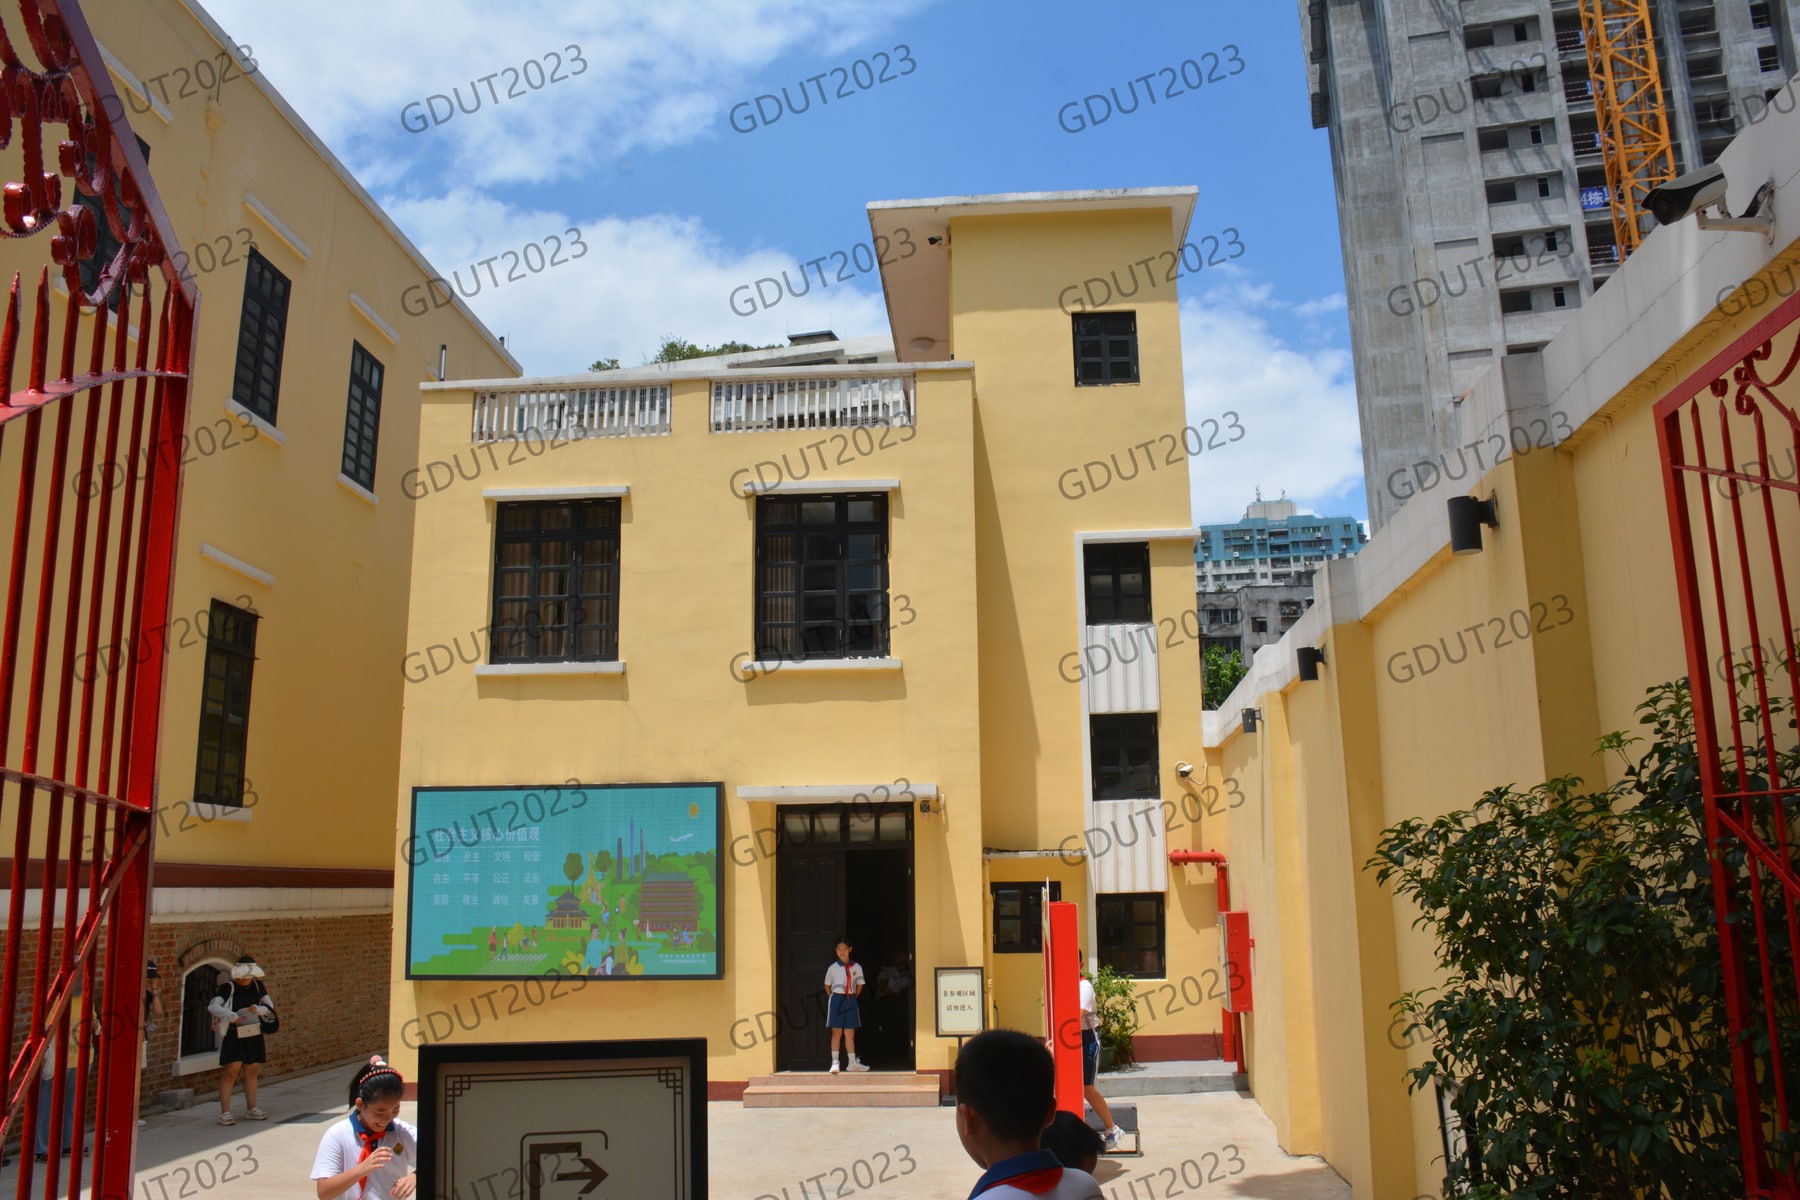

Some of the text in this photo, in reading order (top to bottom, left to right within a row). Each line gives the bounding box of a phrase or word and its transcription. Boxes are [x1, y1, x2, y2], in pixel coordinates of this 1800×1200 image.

[1580, 191, 1604, 206] 4栋
[434, 827, 541, 842] 社会主义核心价值观
[464, 851, 480, 863] 民主
[494, 851, 511, 863] 文明
[433, 873, 450, 885] 自由
[463, 873, 479, 885] 平等
[493, 873, 510, 884] 公正
